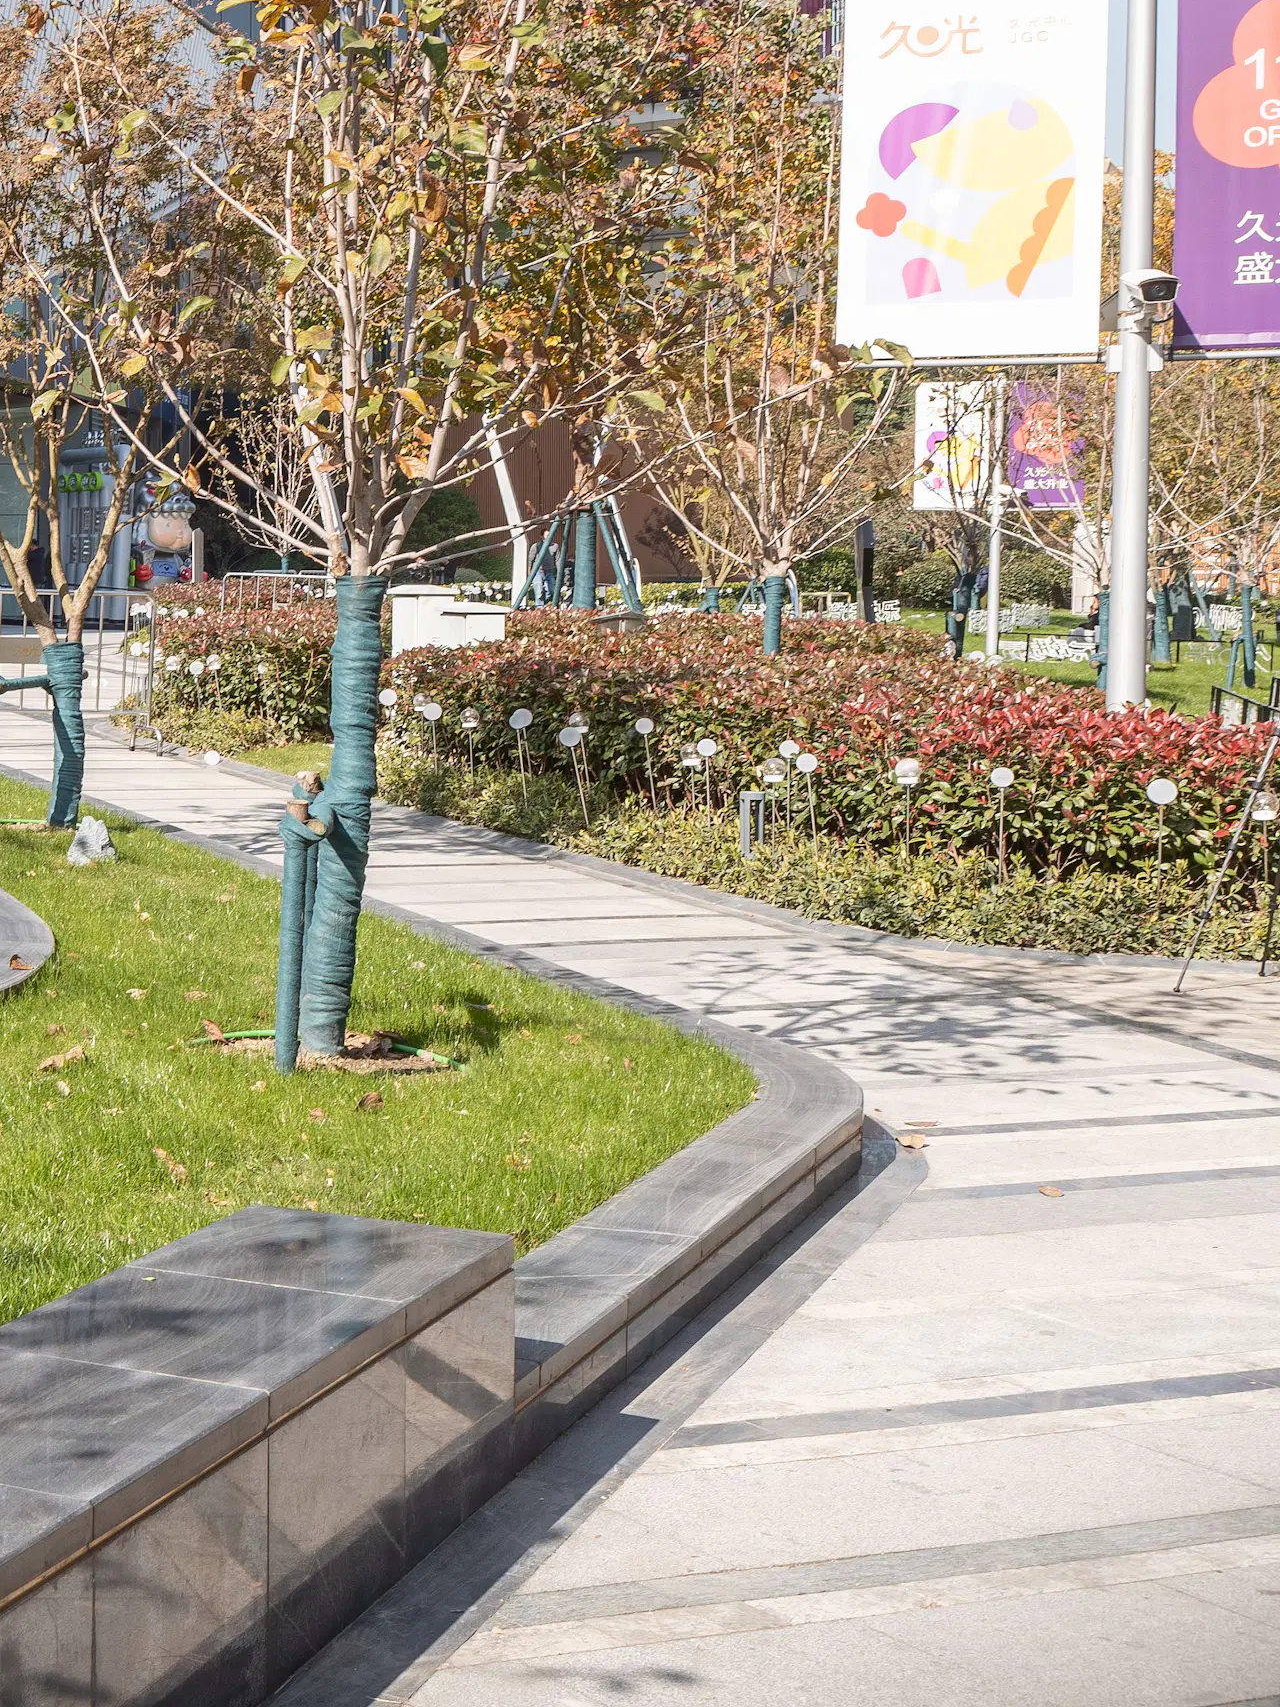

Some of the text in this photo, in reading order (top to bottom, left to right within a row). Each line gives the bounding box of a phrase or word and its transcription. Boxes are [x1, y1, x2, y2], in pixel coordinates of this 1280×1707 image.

[878, 14, 984, 60] 久光
[1008, 30, 1049, 44] JGC
[1244, 48, 1280, 90] 1
[1234, 210, 1280, 244] 久
[1233, 251, 1280, 285] 盛
